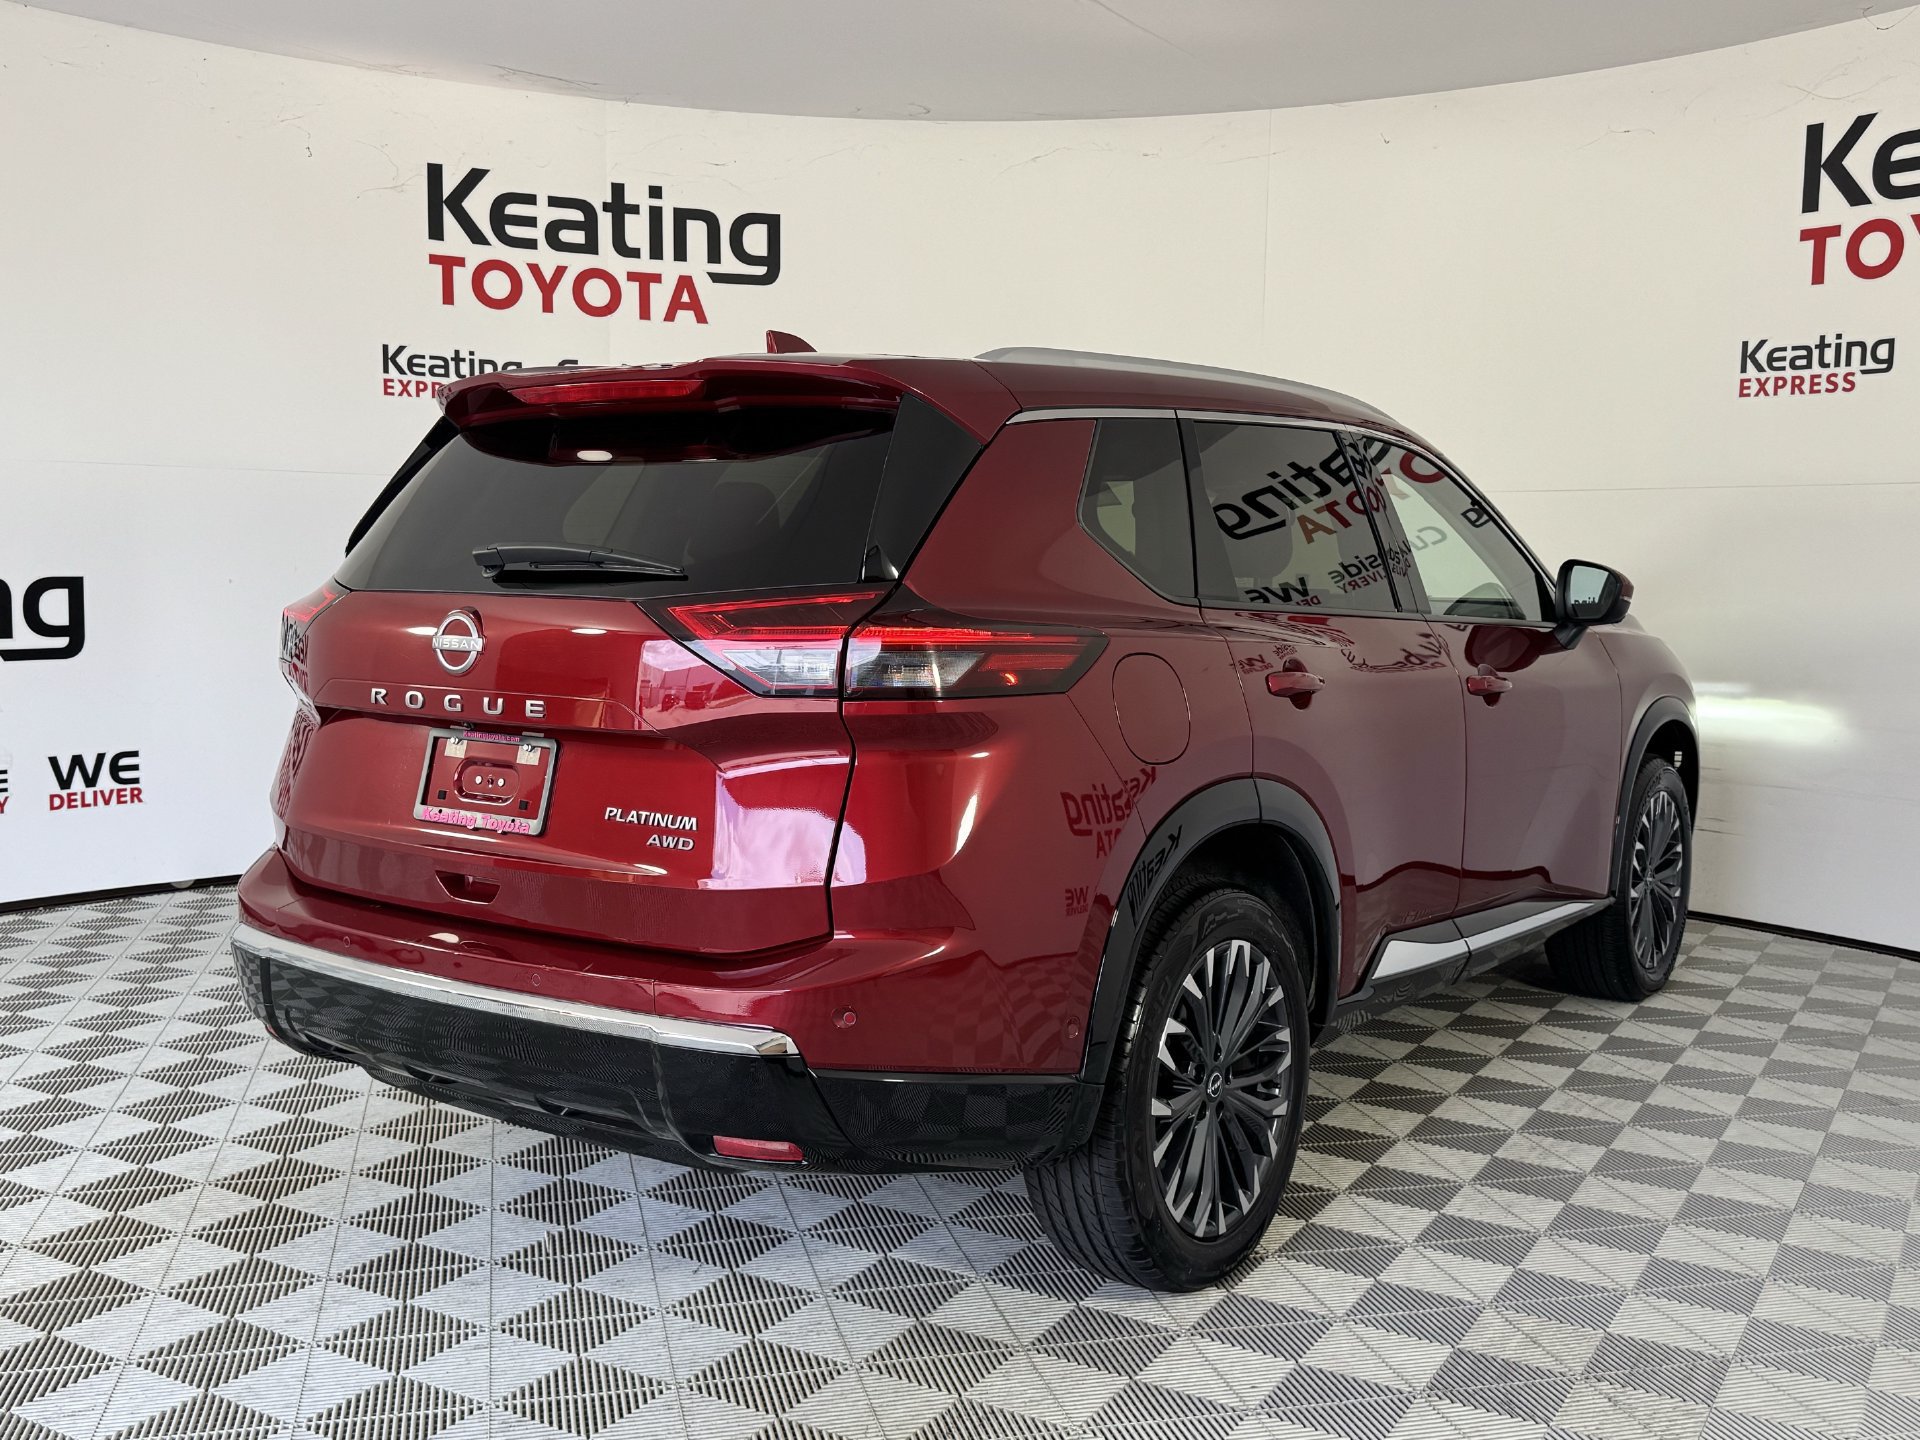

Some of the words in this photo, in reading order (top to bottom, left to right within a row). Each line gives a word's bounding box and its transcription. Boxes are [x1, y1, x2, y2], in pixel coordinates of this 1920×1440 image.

[427, 162, 781, 286] Keating
[428, 254, 709, 324] TOYOTA
[1740, 333, 1896, 375] Keating
[1738, 372, 1857, 398] EXPRESS
[432, 637, 481, 650] NISSAN
[370, 687, 546, 718] ROGUE
[48, 750, 140, 790] WE
[49, 787, 143, 811] DELIVER
[422, 807, 477, 829] Keating
[480, 814, 530, 834] Toyota
[604, 807, 698, 831] PLATINUM
[646, 834, 695, 851] AWD
